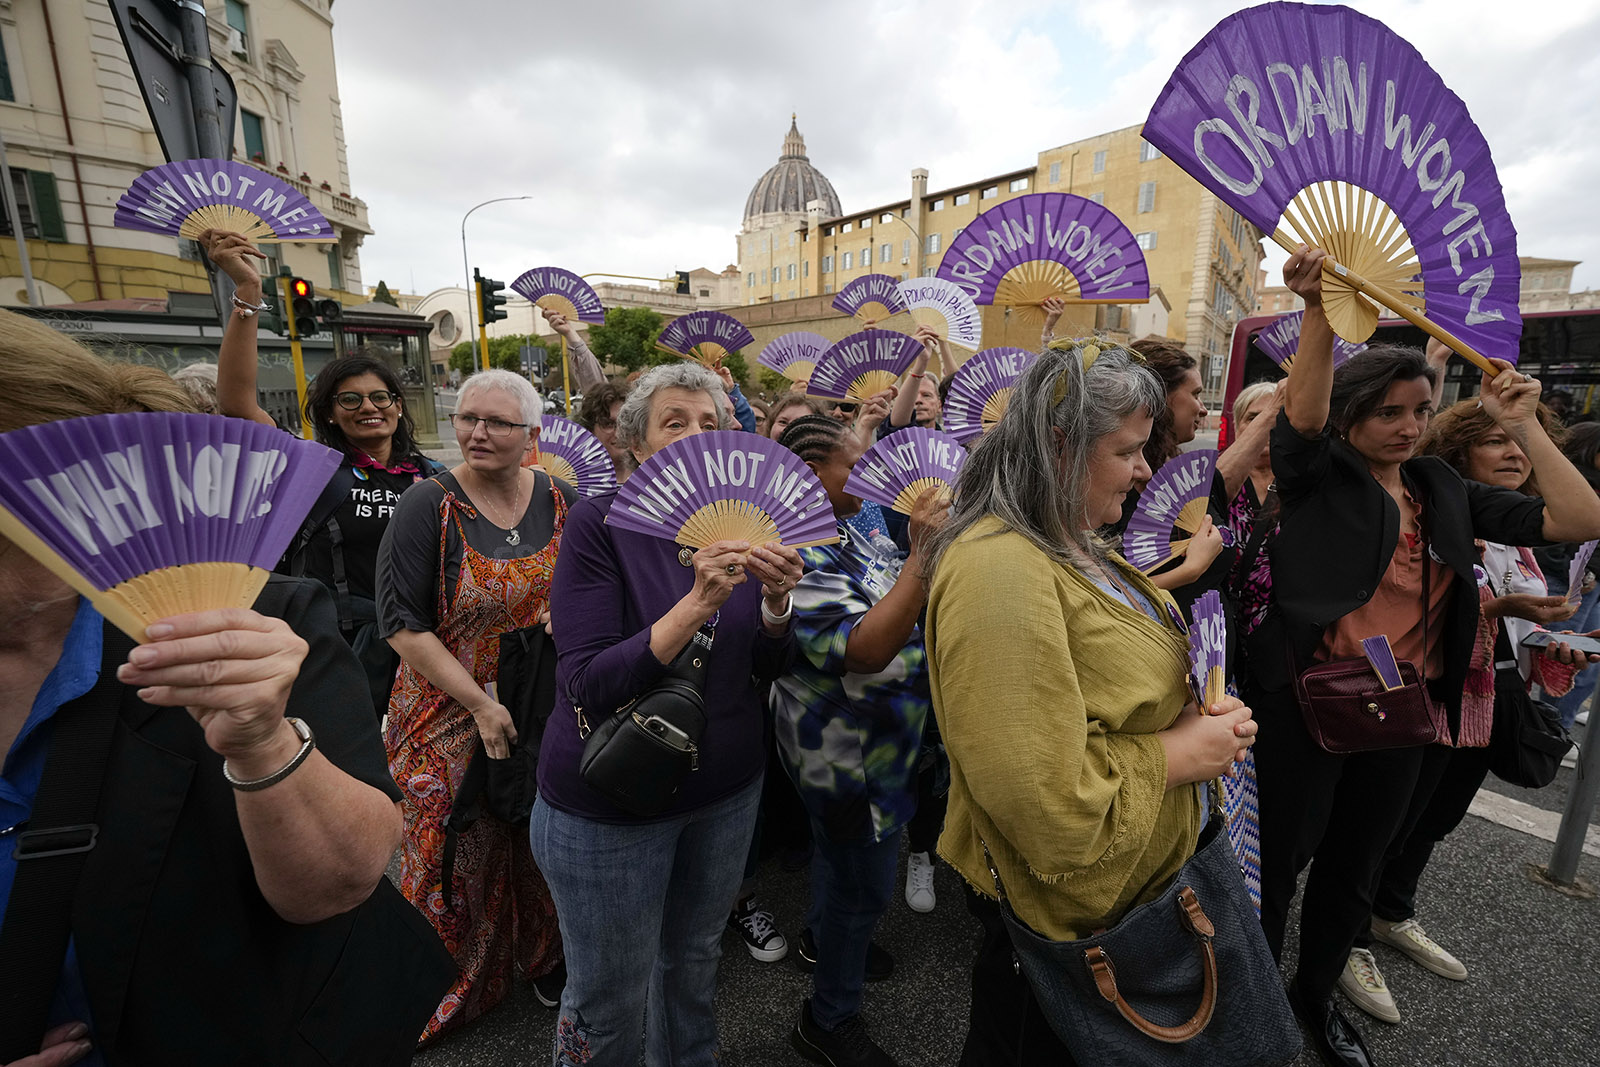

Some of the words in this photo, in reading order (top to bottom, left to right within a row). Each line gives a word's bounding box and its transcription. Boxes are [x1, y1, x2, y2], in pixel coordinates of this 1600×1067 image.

[134, 179, 187, 228] WHY
[182, 170, 256, 201] NOT
[252, 187, 321, 236] ME?
[1193, 55, 1368, 197] ORDAIN
[1384, 79, 1506, 326] WOMEN
[1045, 212, 1134, 294] WOMEN
[516, 272, 545, 296] WHY
[549, 272, 578, 294] NOT
[574, 287, 601, 314] ME?
[842, 284, 867, 308] WHY
[869, 279, 894, 298] NOT
[945, 295, 967, 317] PAS
[686, 317, 709, 337] NOT
[713, 319, 742, 340] ME?
[768, 344, 793, 367] WHY
[797, 343, 820, 359] NOT
[811, 355, 845, 391] WHY
[839, 340, 871, 369] NOT
[946, 389, 970, 431] WHY
[958, 360, 993, 396] NOT
[994, 352, 1027, 379] ME?
[539, 418, 587, 448] WHY
[886, 441, 920, 474] NOT
[1171, 455, 1210, 497] ME?
[22, 443, 164, 556] WHY
[350, 488, 383, 503] THE
[628, 457, 697, 526] WHY
[703, 448, 766, 488] NOT
[764, 462, 827, 520] ME?
[1143, 480, 1180, 523] NOT
[355, 504, 373, 518] IS
[1130, 530, 1160, 568] WHY
